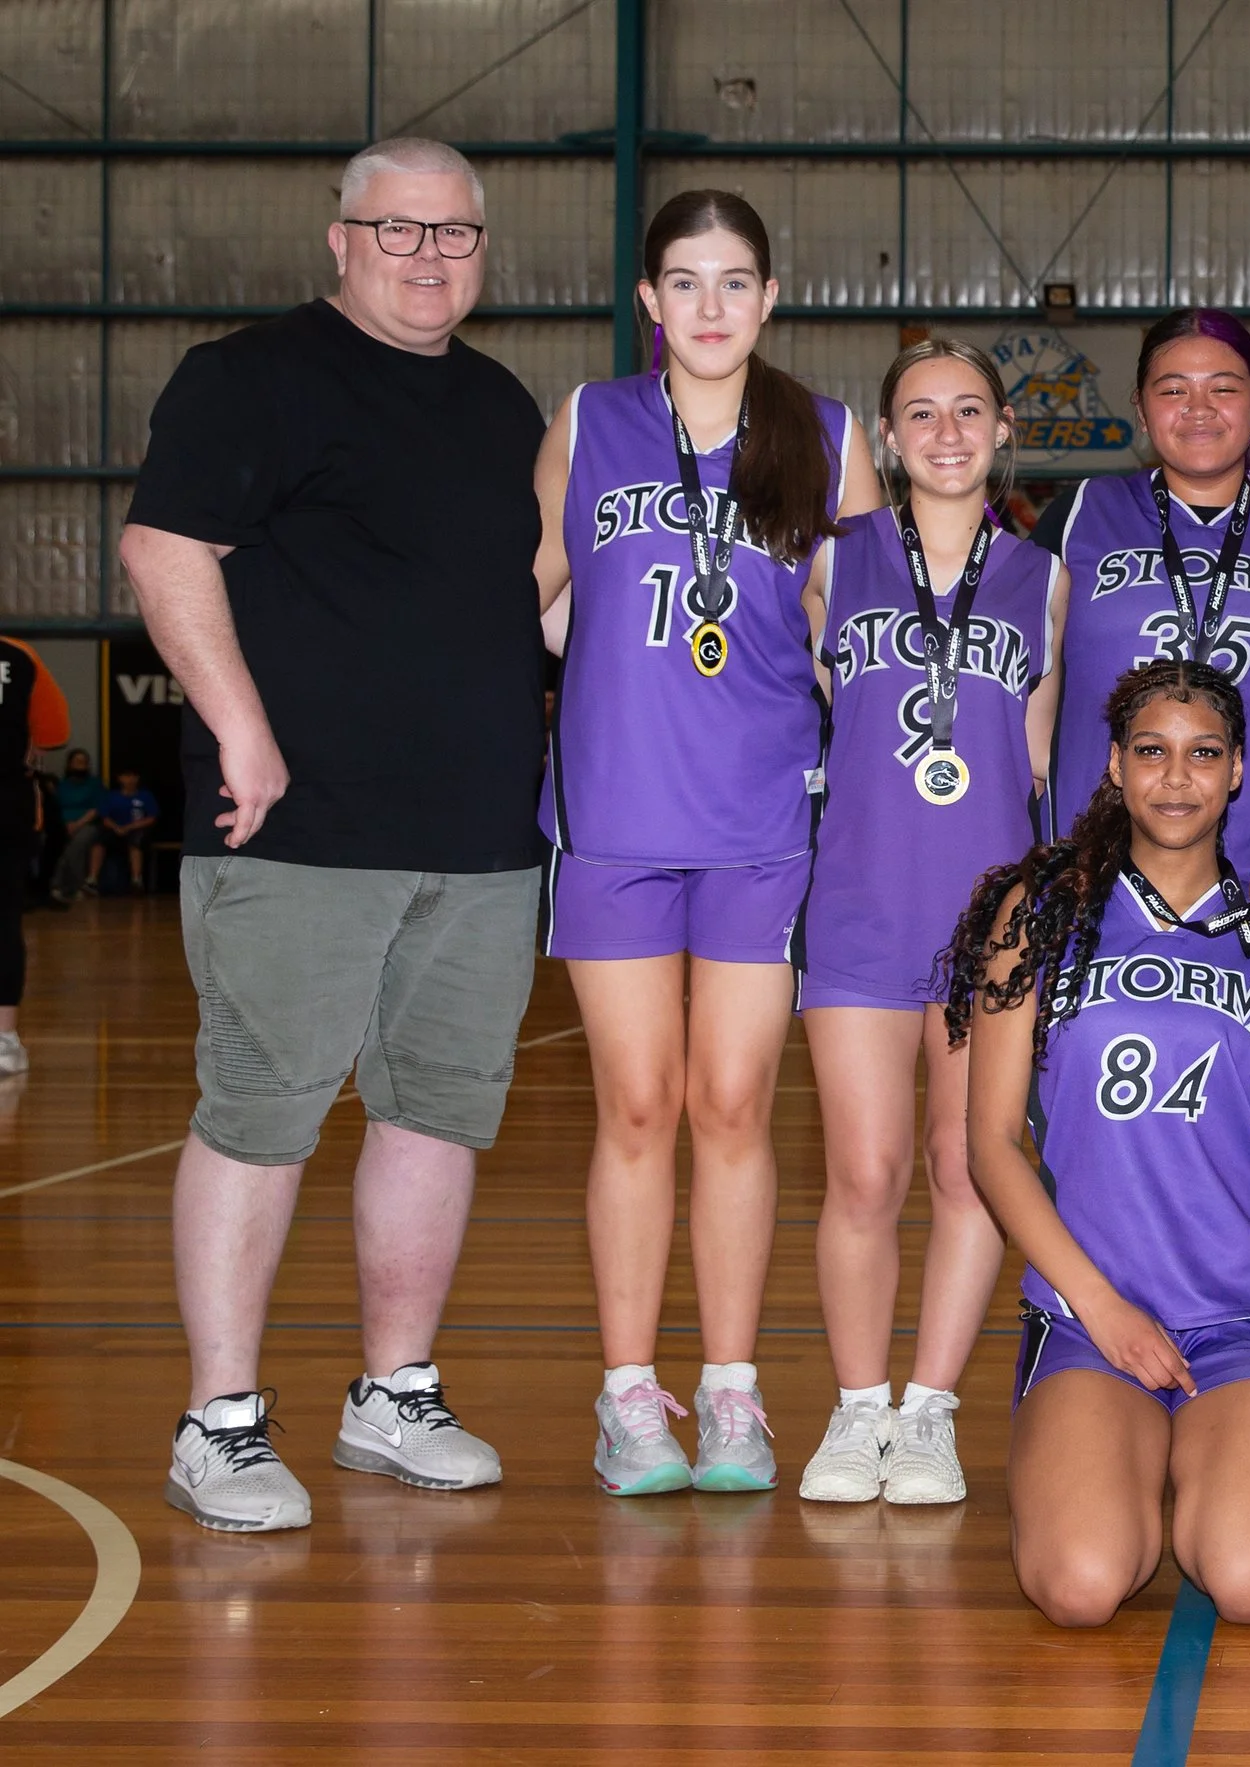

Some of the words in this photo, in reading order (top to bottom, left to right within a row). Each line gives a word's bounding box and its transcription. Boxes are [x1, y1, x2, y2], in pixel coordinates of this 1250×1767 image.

[1239, 483, 1250, 515] PACERS
[722, 500, 738, 543] PACERS
[695, 532, 708, 576] PACERS
[974, 530, 988, 564] PACERS
[911, 550, 926, 588] PACERS
[1174, 575, 1190, 613] PACERS
[1212, 572, 1227, 611] PACERS
[947, 627, 960, 671] PACERS
[893, 682, 958, 768] 9
[1145, 894, 1177, 922] PACERS
[1208, 908, 1249, 931] PACERS
[1096, 1033, 1221, 1123] 84
